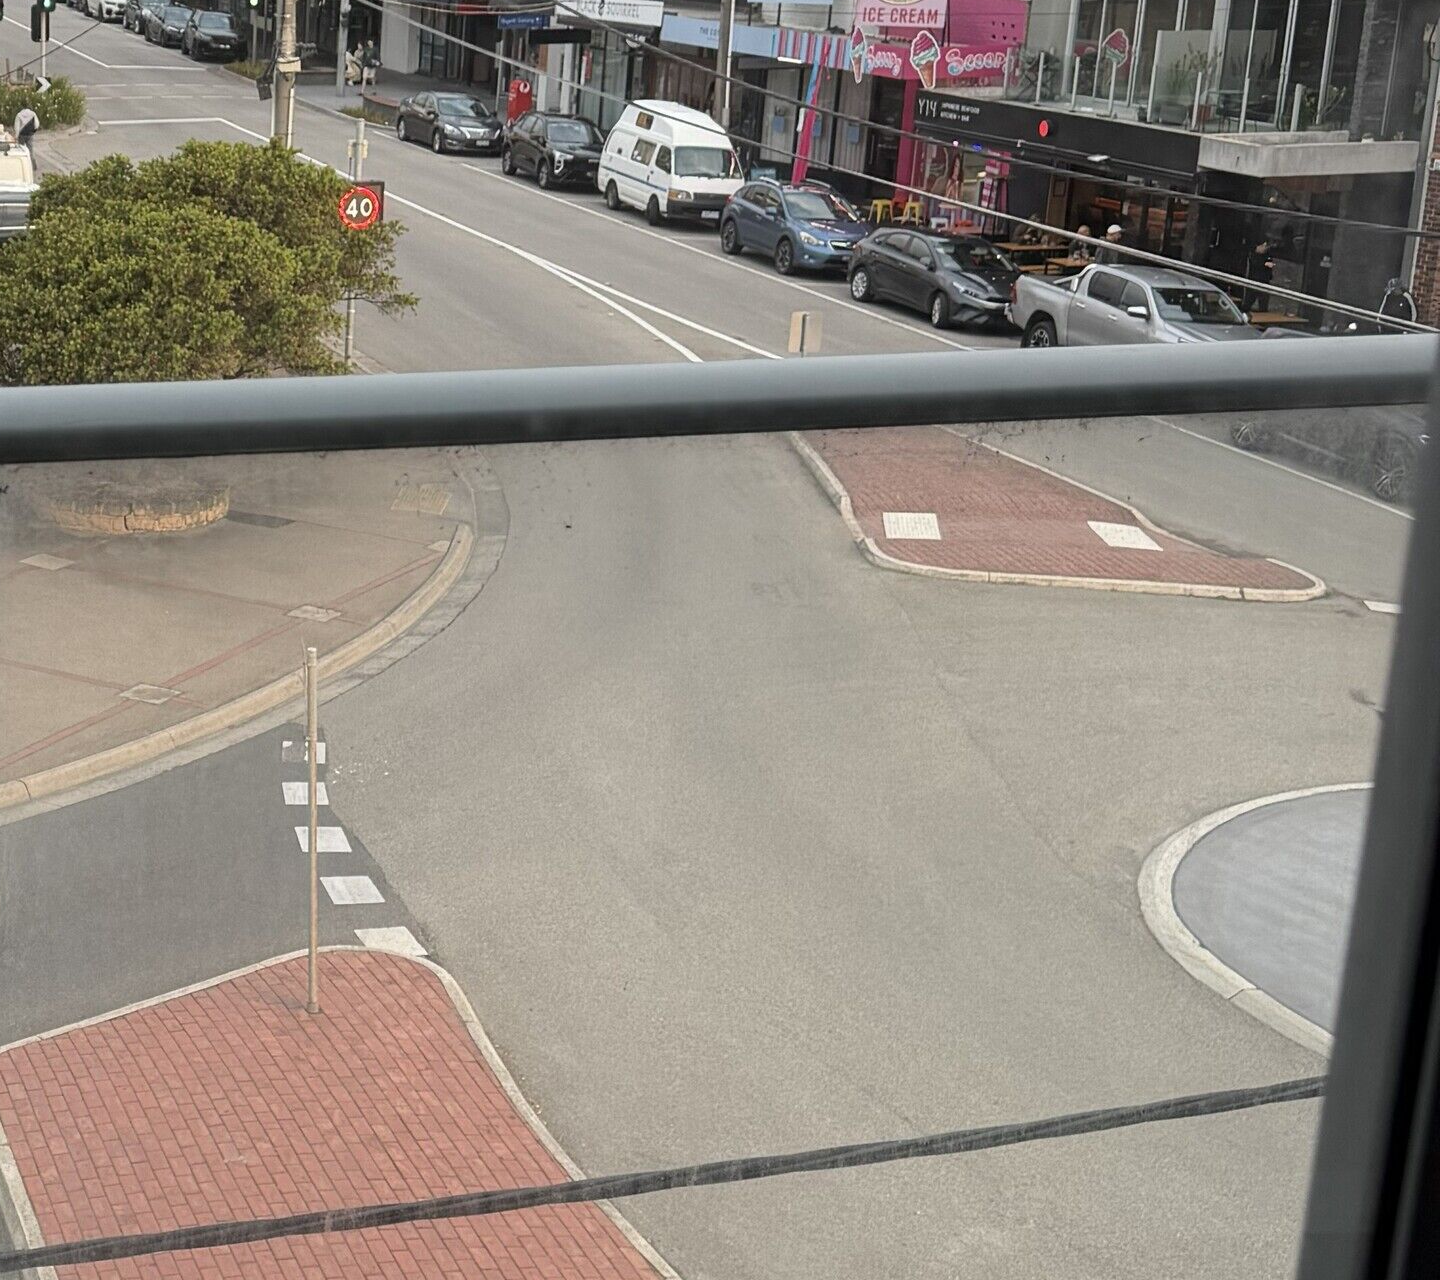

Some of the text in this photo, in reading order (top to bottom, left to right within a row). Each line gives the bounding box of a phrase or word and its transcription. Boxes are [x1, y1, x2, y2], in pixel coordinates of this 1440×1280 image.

[862, 7, 938, 24] ICE CREAM
[345, 198, 373, 218] 40
